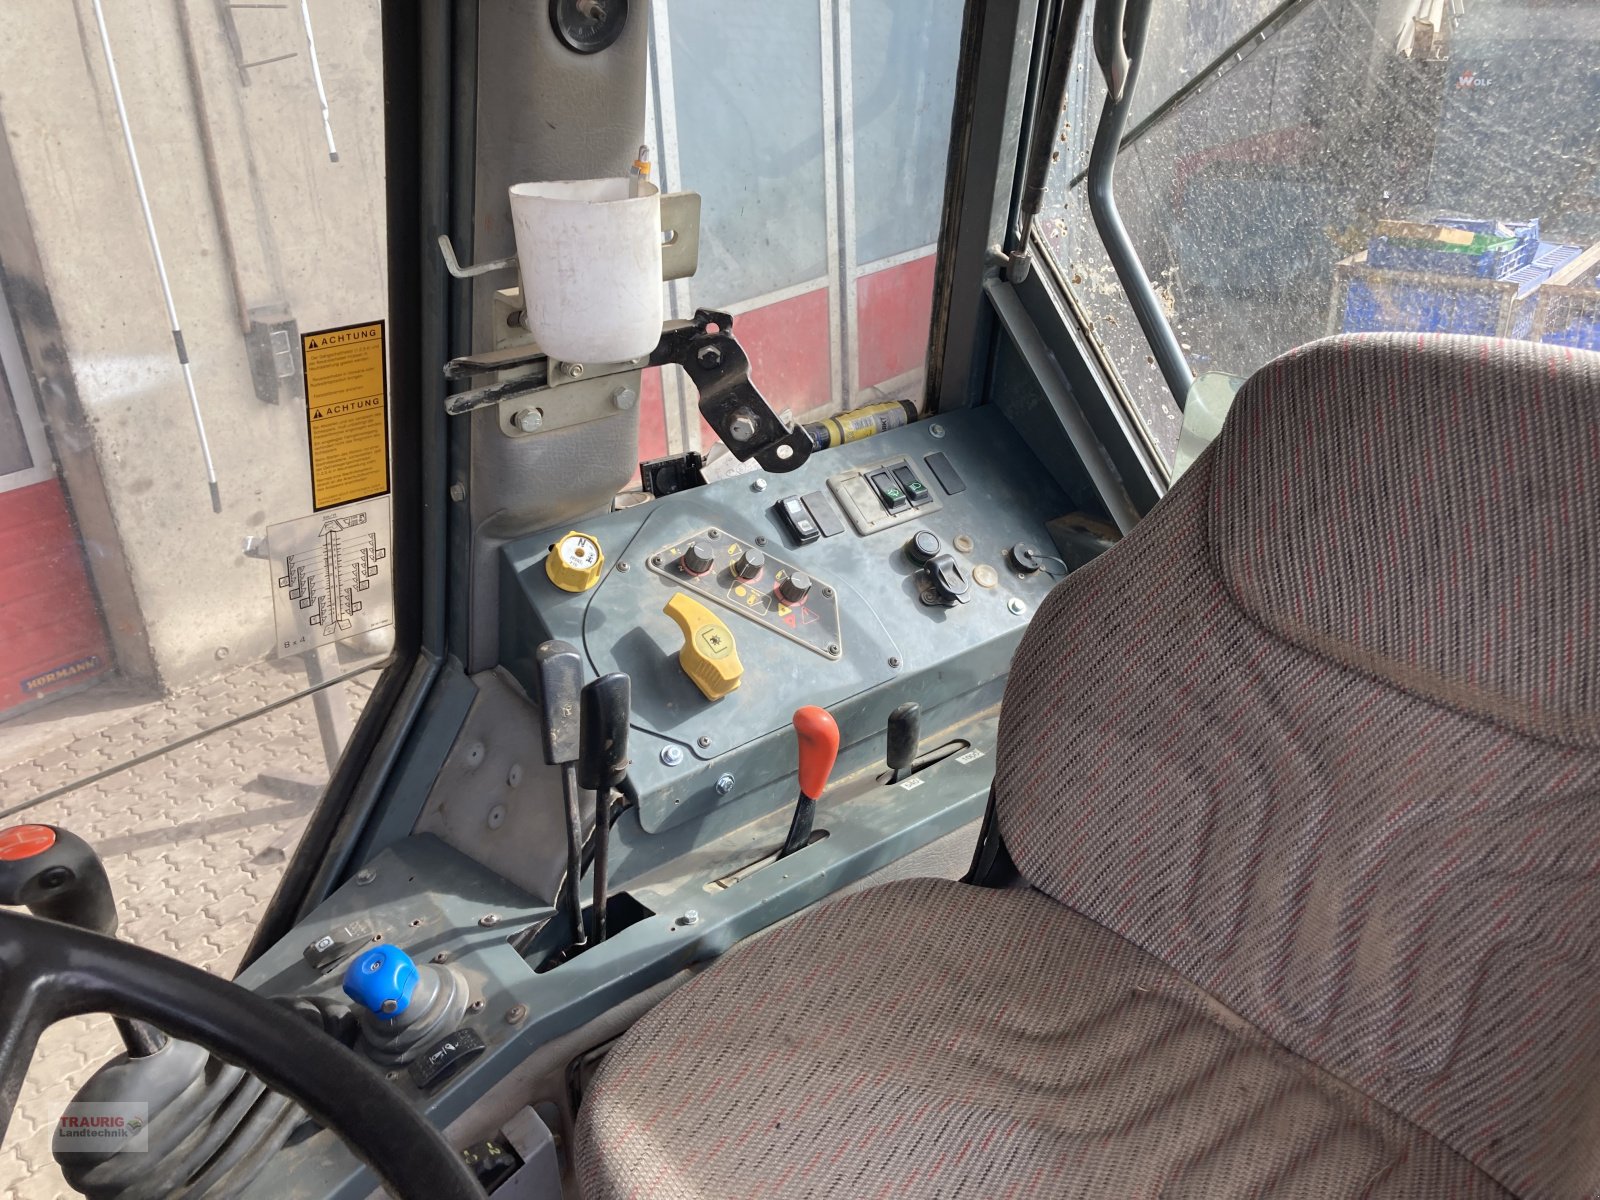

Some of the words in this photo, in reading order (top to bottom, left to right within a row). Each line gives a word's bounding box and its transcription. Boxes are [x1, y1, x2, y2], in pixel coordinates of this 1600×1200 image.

[321, 329, 377, 346] ACHTUNG
[326, 397, 380, 415] ACHTUNG
[284, 641, 290, 649] 8
